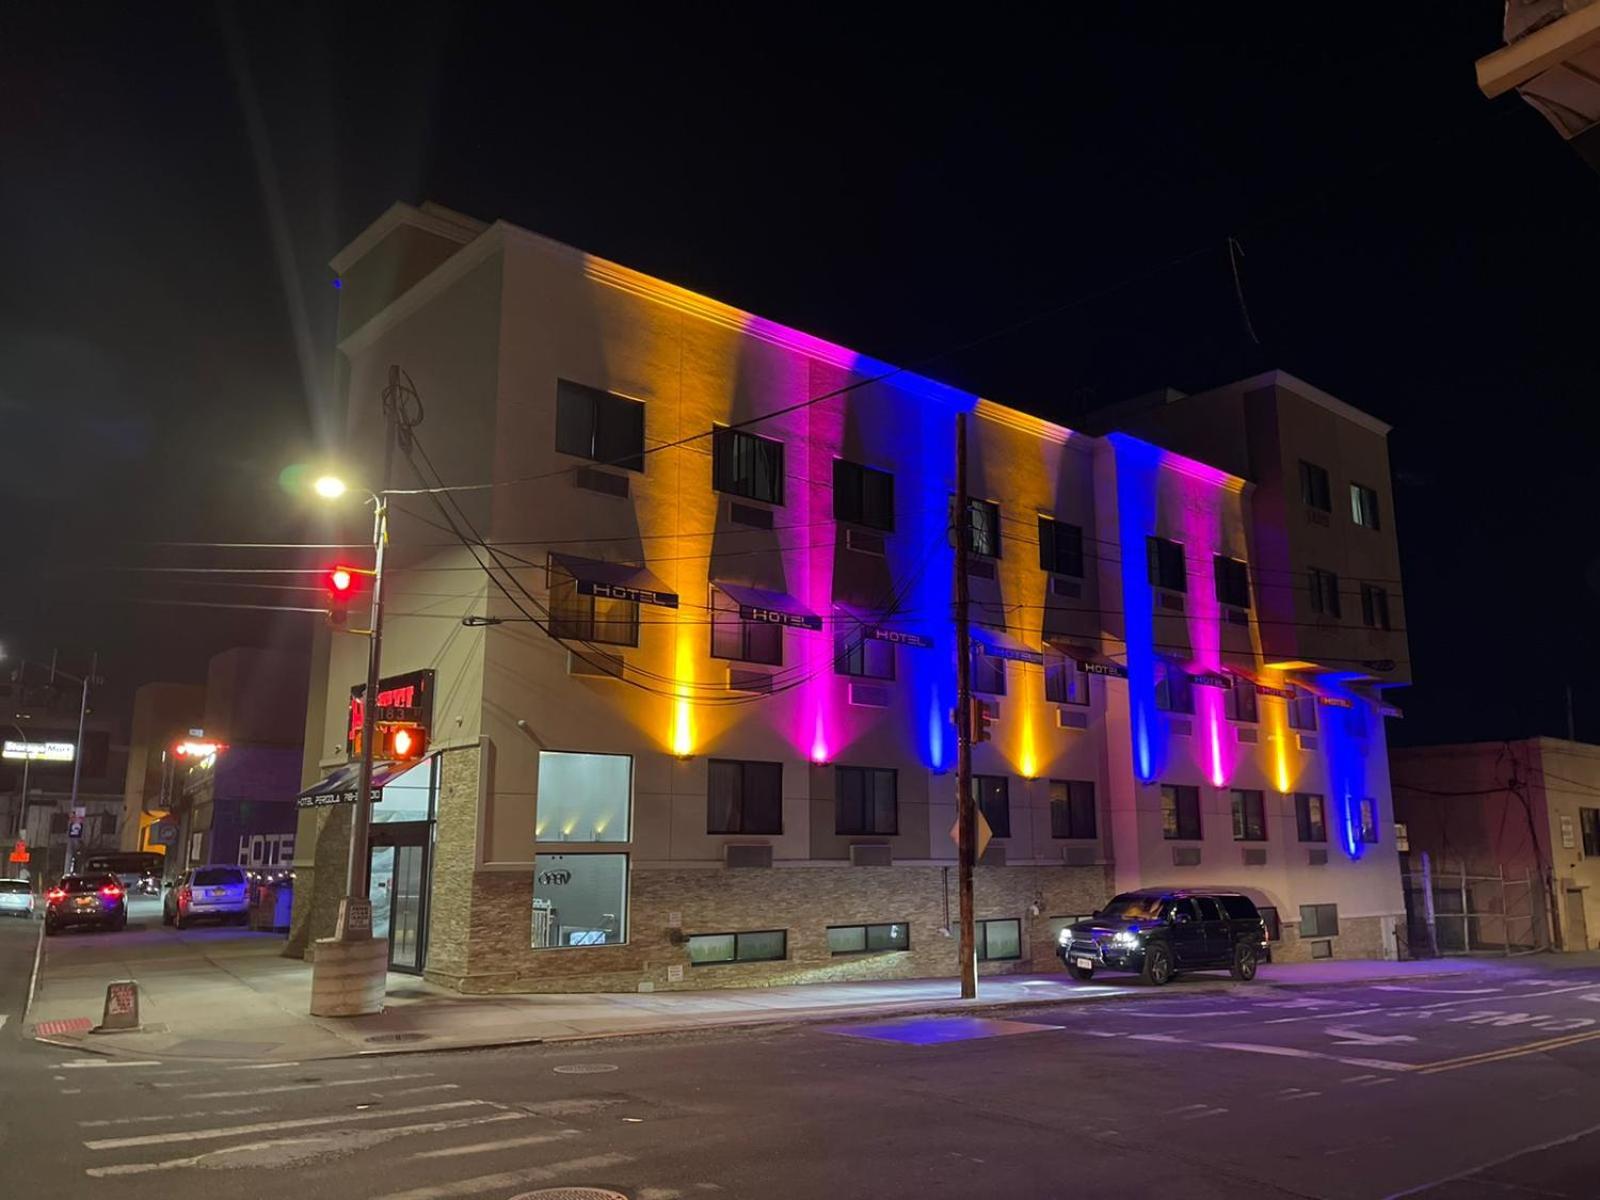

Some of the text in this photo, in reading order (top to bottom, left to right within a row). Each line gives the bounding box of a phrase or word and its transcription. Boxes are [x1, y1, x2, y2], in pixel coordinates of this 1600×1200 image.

[593, 584, 666, 604] HOTEL
[753, 608, 812, 628] HOTEL
[876, 630, 926, 647] HOTEL
[1085, 663, 1121, 676] HOTEL
[237, 833, 294, 868] HOTE
